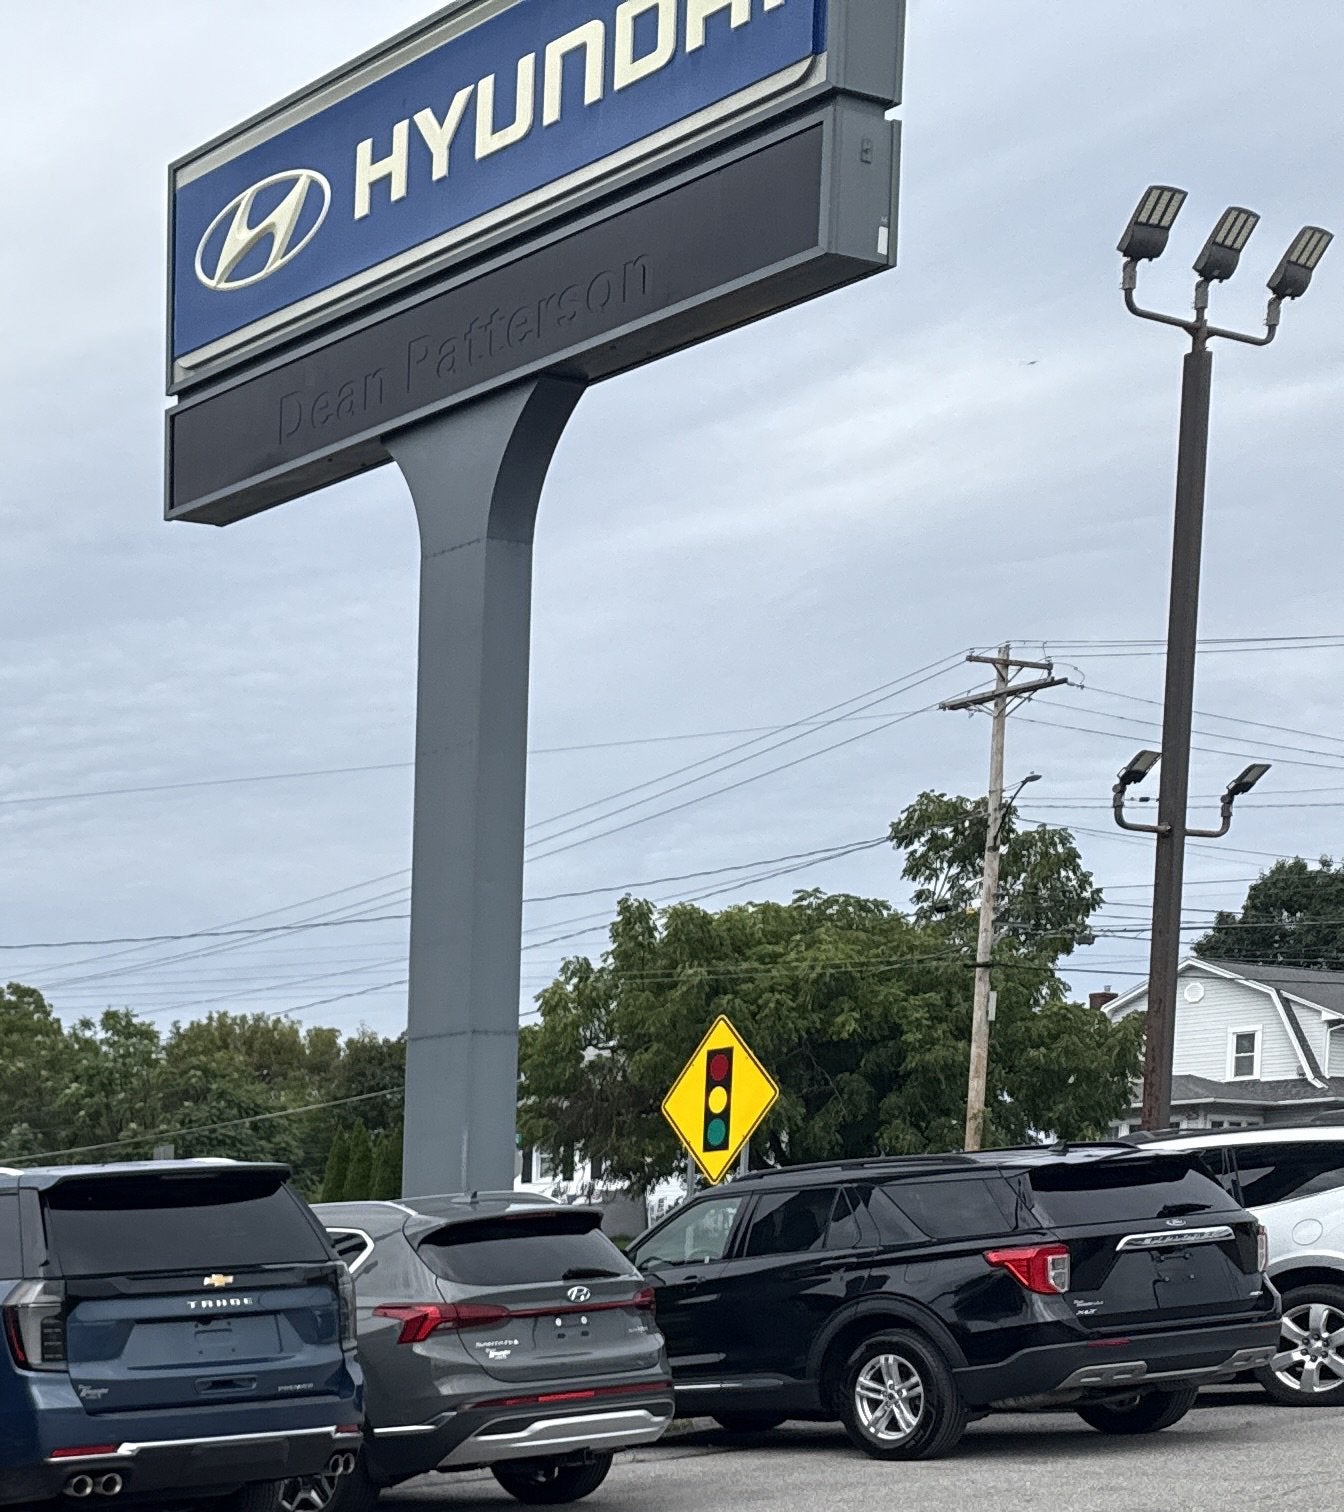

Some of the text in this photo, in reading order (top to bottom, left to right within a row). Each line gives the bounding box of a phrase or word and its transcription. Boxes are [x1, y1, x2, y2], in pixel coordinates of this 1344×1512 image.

[354, 0, 786, 220] HYUNDA
[278, 253, 651, 445] Dean Patterson
